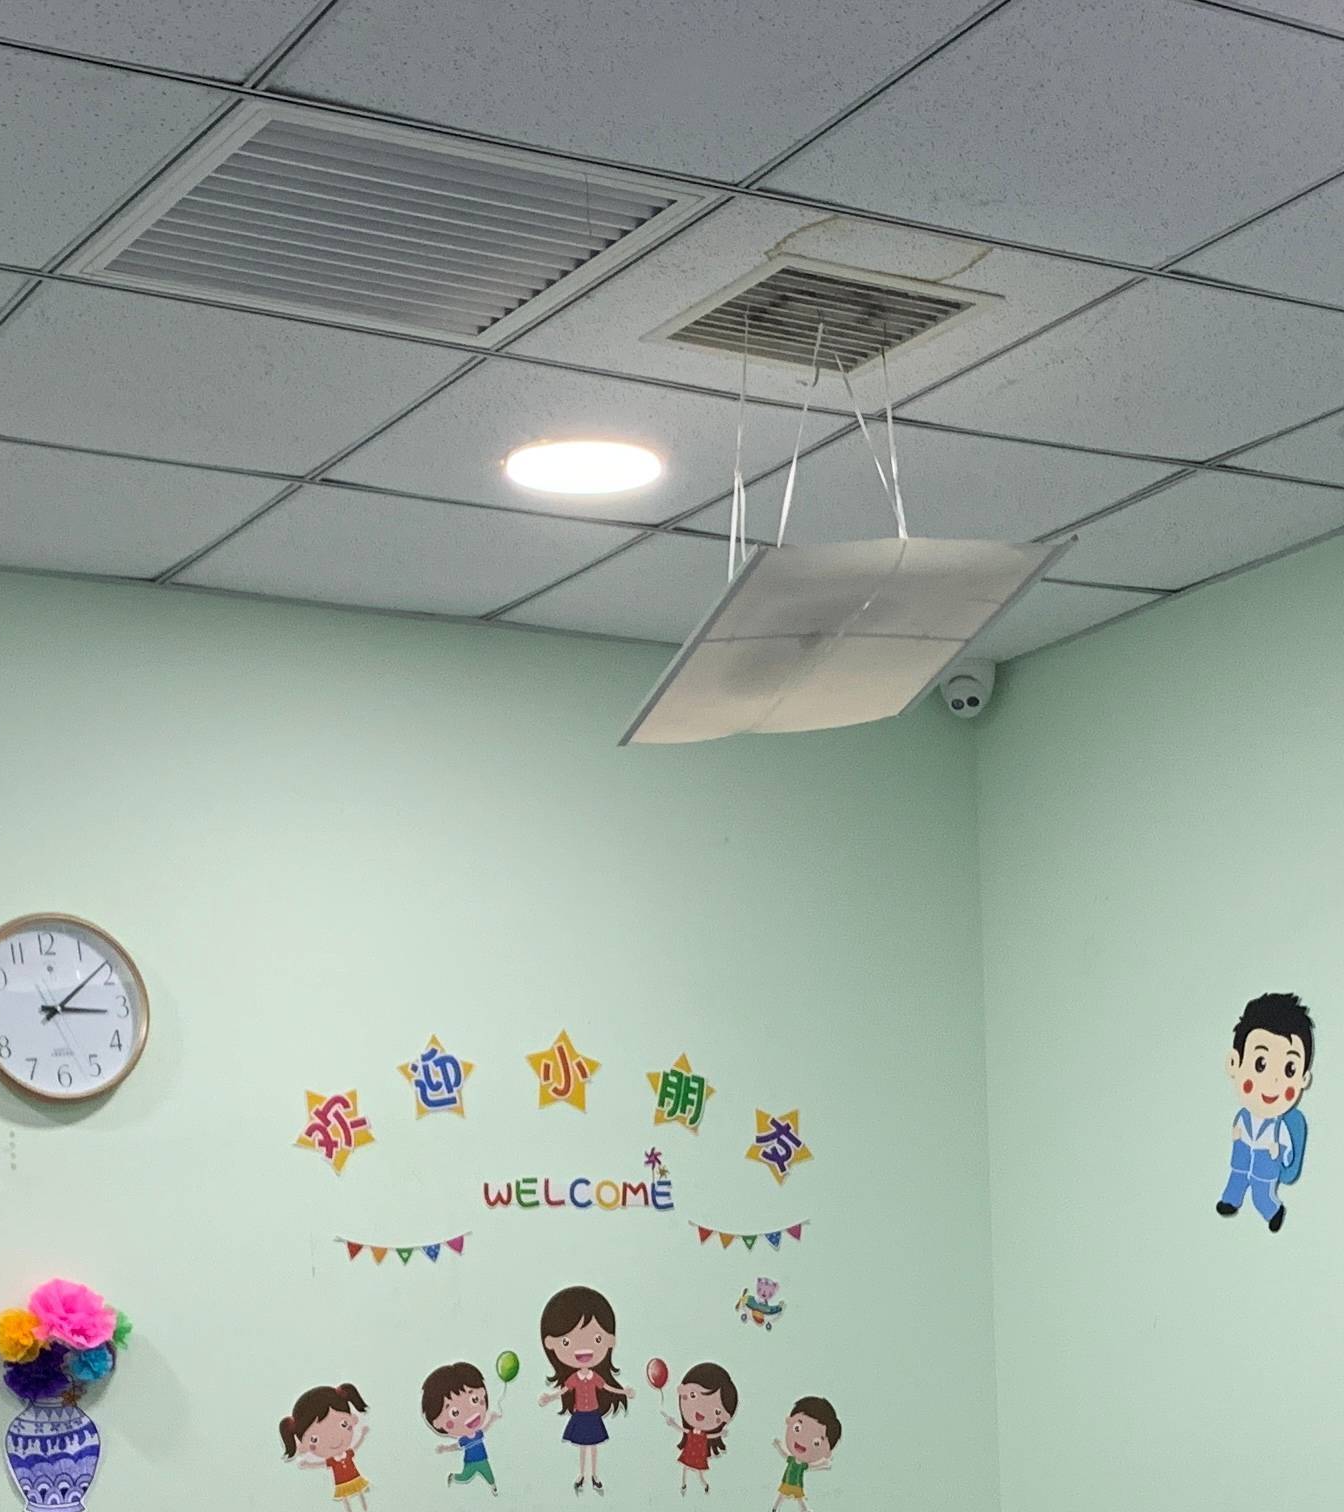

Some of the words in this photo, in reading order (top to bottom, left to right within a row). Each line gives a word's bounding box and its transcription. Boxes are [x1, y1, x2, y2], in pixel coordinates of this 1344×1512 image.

[10, 942, 25, 965] 11
[37, 932, 56, 956] 12
[76, 939, 82, 961] 1
[103, 962, 115, 986] 2
[115, 995, 130, 1018] 3
[109, 1029, 123, 1052] 4
[25, 1058, 38, 1080] 7
[57, 1064, 72, 1088] 6
[88, 1054, 102, 1077] 5
[483, 1177, 674, 1210] WELCOME
